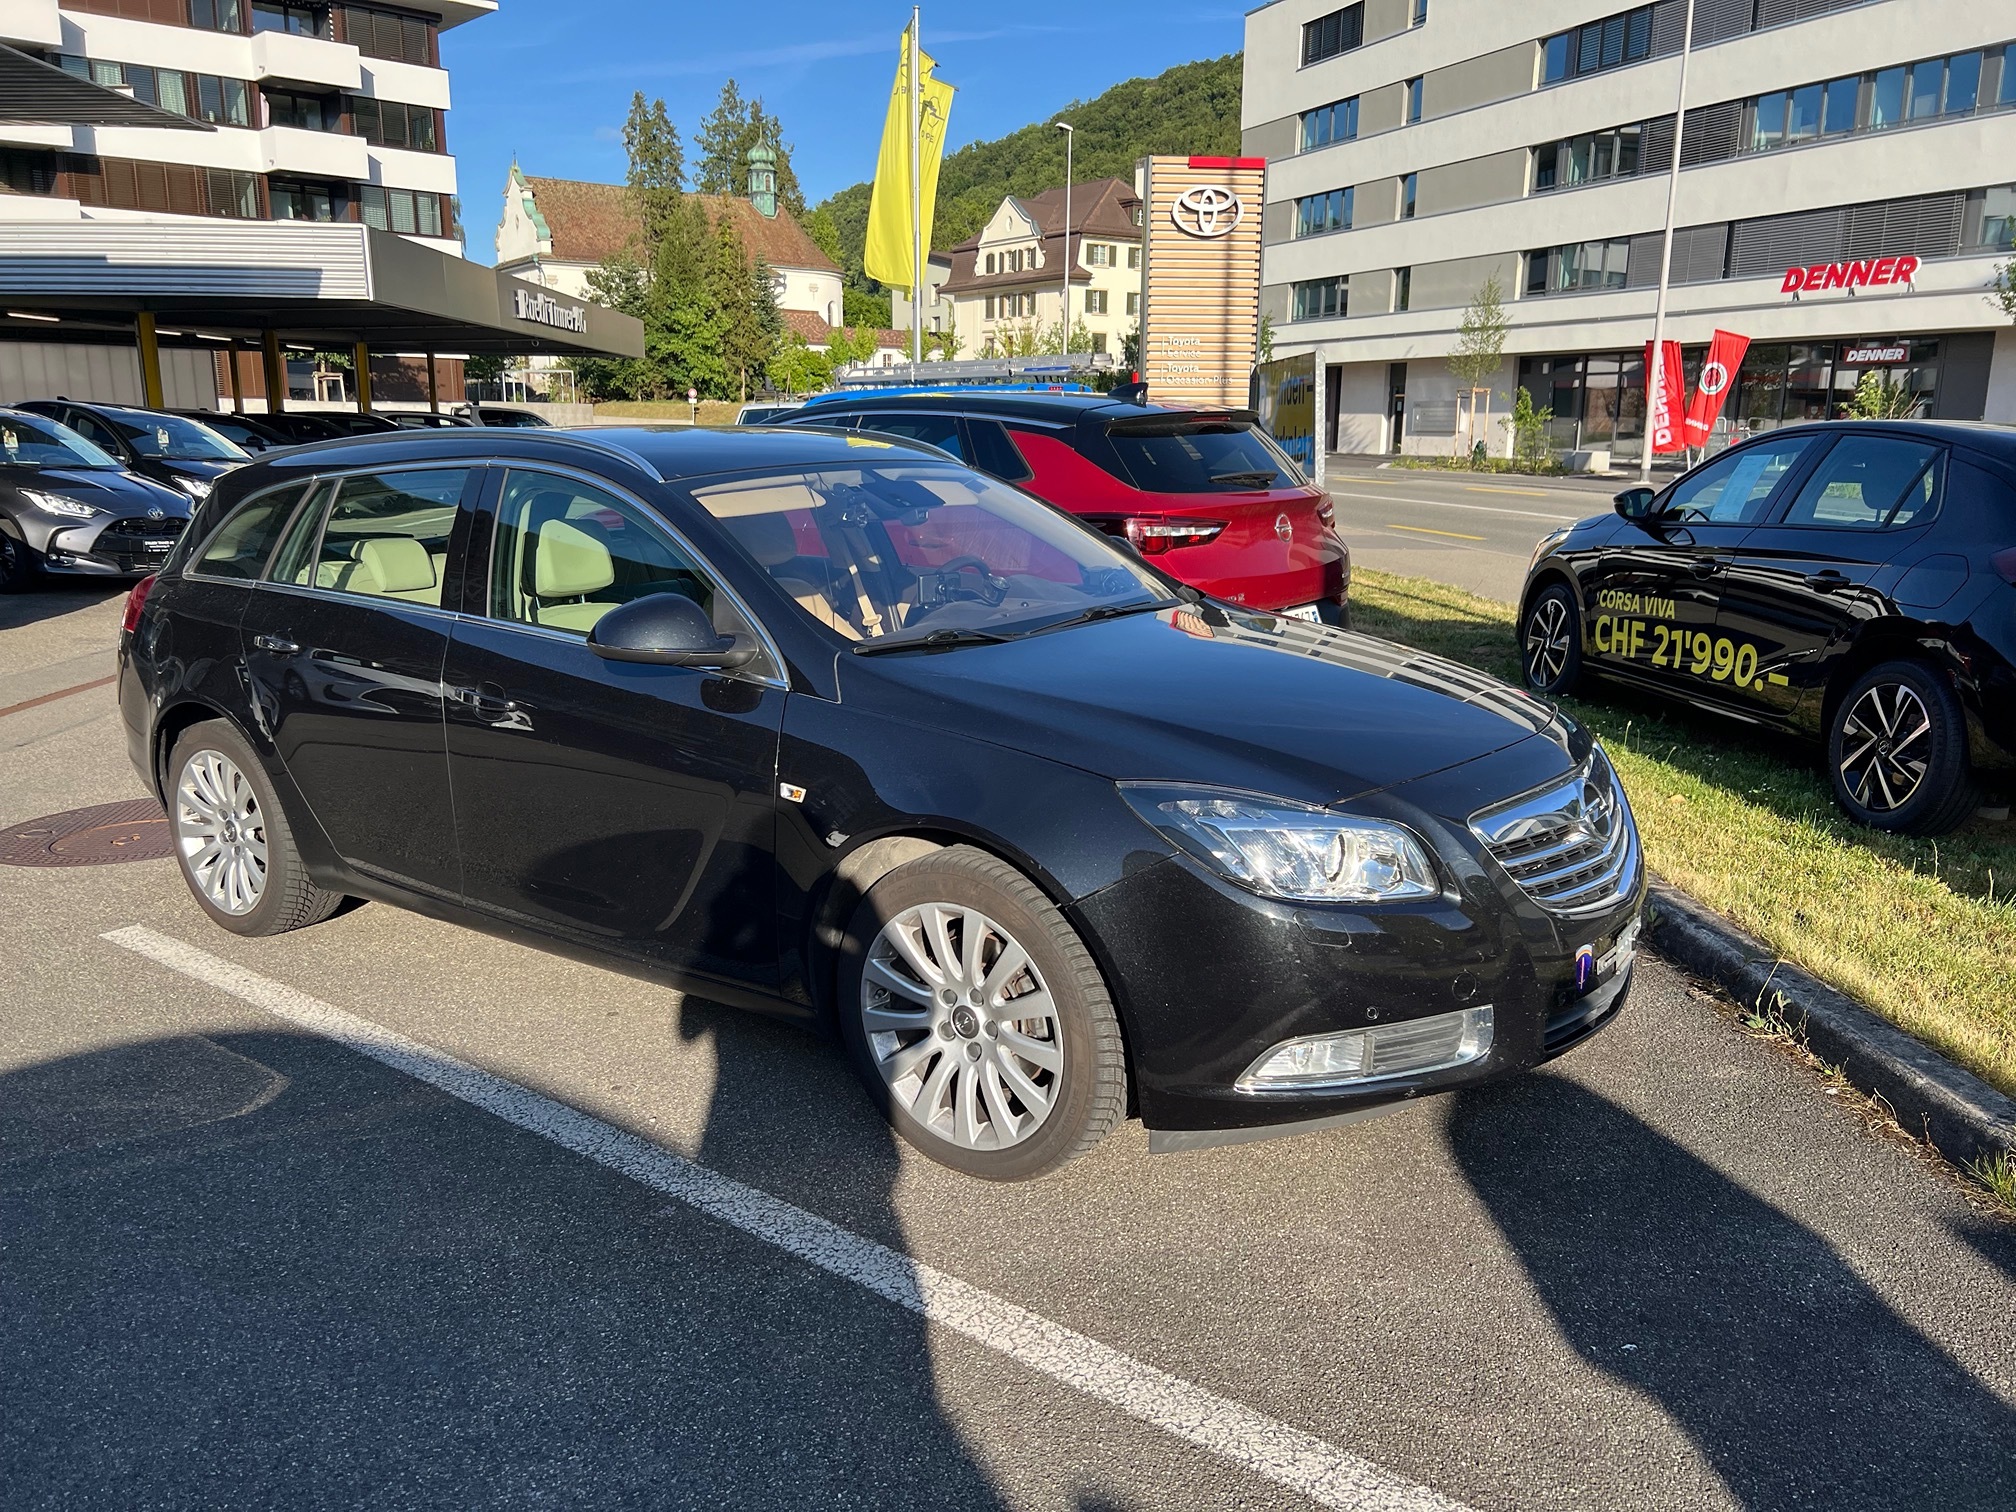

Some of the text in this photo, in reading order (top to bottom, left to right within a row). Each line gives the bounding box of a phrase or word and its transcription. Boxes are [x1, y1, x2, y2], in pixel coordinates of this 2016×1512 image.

[1781, 256, 1922, 293] DENNER
[1167, 336, 1200, 348] Toyota
[1846, 348, 1905, 363] DENNER
[1167, 363, 1199, 375] Toyota
[1213, 374, 1233, 386] Plus
[1599, 589, 1676, 620] CORSA VIVA
[1595, 614, 1646, 659] CHF
